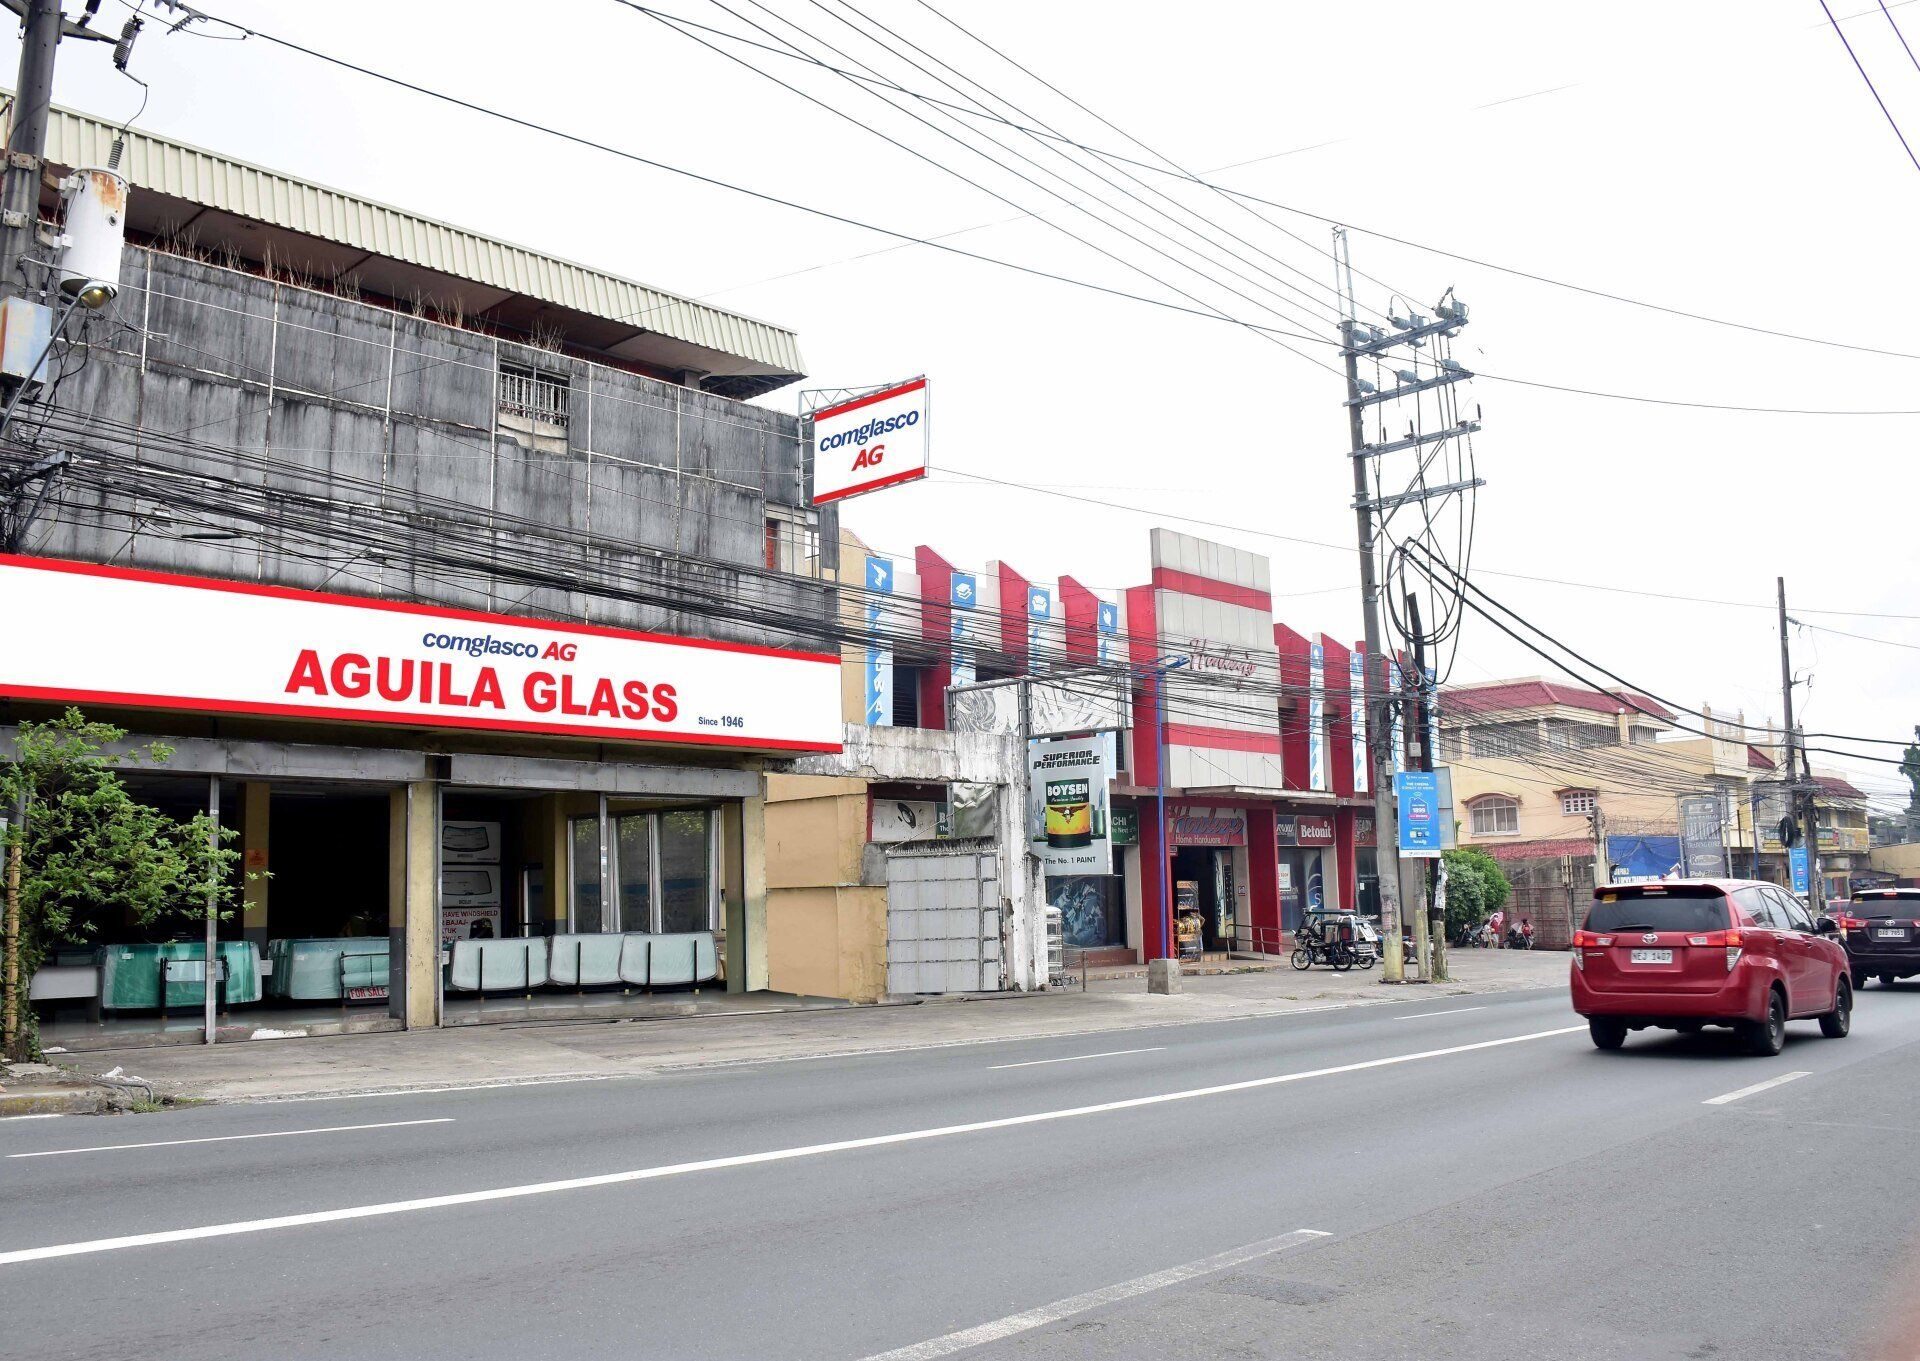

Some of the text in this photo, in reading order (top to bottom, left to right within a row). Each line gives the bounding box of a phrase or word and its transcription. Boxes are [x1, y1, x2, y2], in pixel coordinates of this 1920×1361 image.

[820, 410, 919, 452] comglasco
[851, 444, 885, 472] AG
[422, 632, 578, 662] comglasco AG
[284, 649, 678, 723] AGUILA GLASS
[698, 715, 744, 729] Since 1946
[1033, 755, 1101, 770] PERFORMANCE
[1042, 750, 1093, 762] SUPERIOR
[1047, 783, 1088, 797] BOYSEN
[1300, 820, 1332, 838] Betonit
[1175, 834, 1221, 843] Home Hardware
[461, 910, 498, 918] WINDSHIELD
[351, 987, 386, 998] FOR SALE
